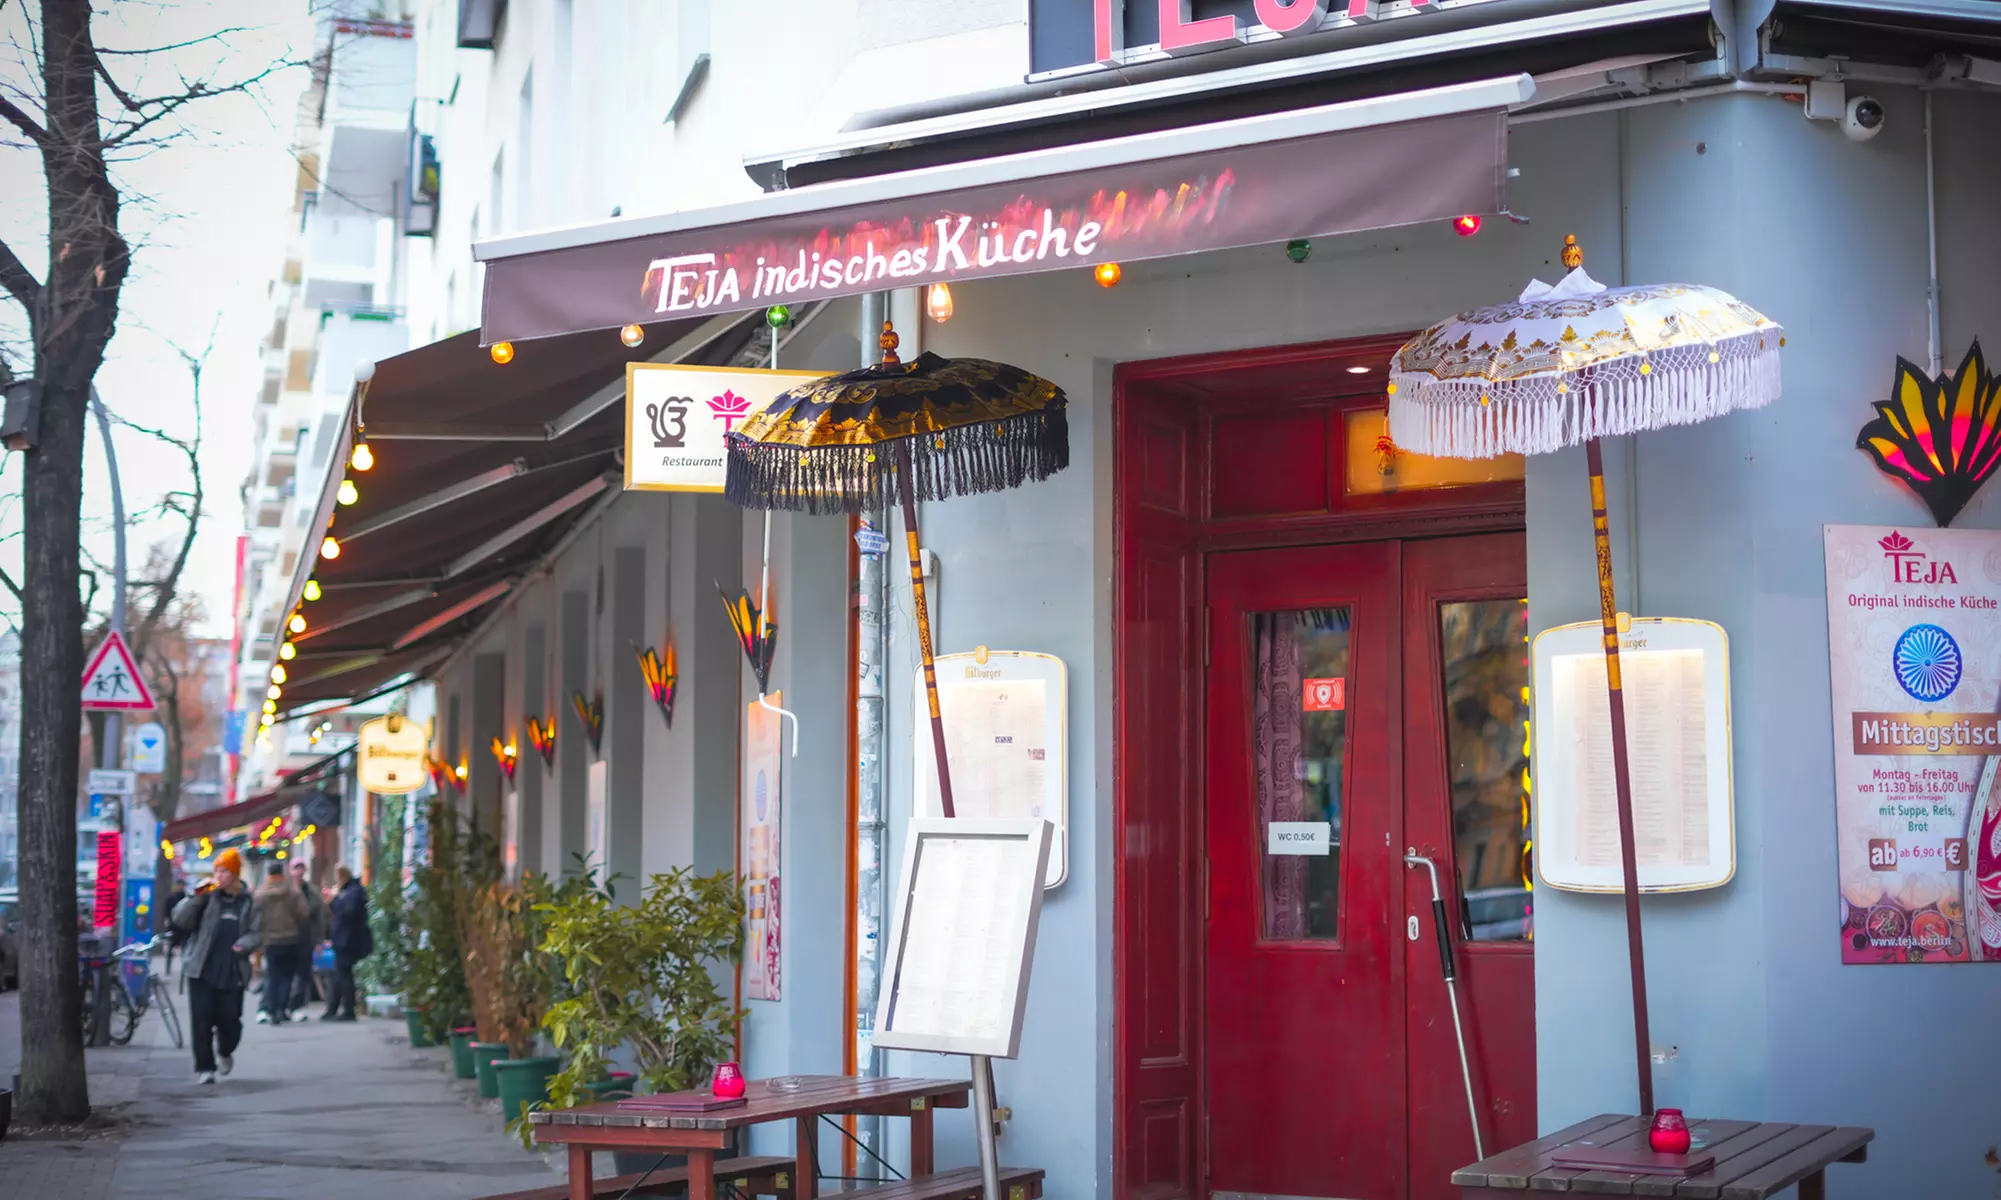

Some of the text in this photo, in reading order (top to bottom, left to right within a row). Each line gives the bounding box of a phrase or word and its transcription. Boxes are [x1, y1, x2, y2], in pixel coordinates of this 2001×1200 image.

[649, 208, 1101, 313] TEJA indisches Küche
[662, 456, 723, 468] Restaurant
[1884, 552, 1958, 584] TEJA
[1848, 594, 1998, 610] Original indische Küche
[1872, 769, 1911, 782] Montag
[1922, 769, 1959, 782] Freitag
[1857, 782, 1974, 793] von 11.30 bis 16.00 Uhr
[1879, 805, 1955, 818] mit Suppe, Reis,
[1908, 821, 1928, 832] Brot
[1277, 832, 1292, 841] WC
[1871, 841, 1961, 865] ab ab 6,90 € €
[1870, 936, 1951, 949] www.teja.berlin
